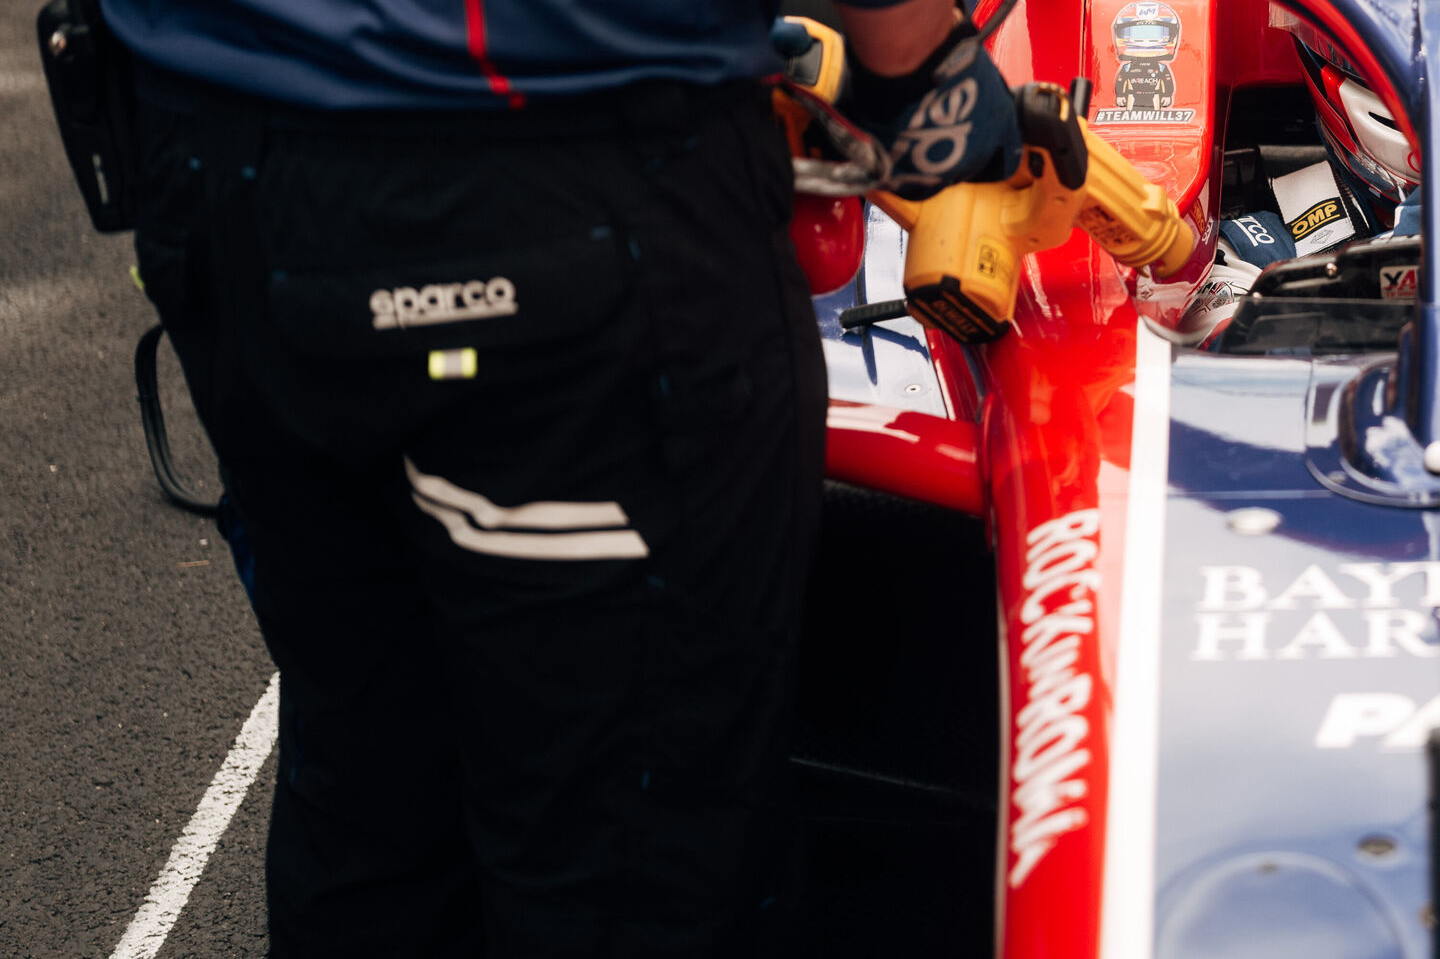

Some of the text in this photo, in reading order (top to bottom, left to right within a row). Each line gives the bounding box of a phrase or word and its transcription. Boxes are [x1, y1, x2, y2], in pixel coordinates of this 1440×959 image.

[1096, 110, 1194, 122] #TEAMWILL37
[1292, 203, 1338, 235] OMP
[369, 276, 519, 330] sparco
